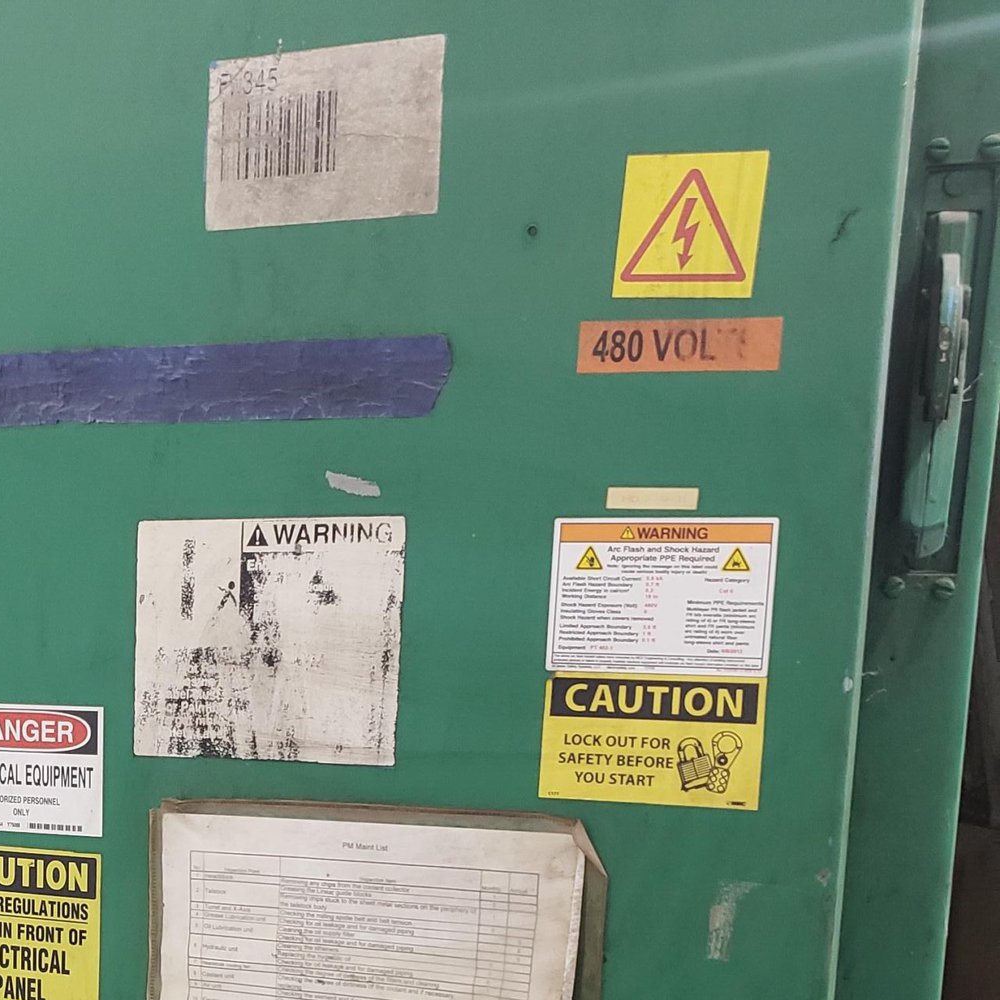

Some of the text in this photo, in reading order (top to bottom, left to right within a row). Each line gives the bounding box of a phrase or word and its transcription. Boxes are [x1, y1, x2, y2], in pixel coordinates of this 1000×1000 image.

[593, 328, 746, 362] 480 VOL
[274, 522, 392, 545] WARNING
[637, 528, 708, 539] WARNING
[565, 683, 743, 718] CAUTION
[564, 734, 670, 750] LOCK OUT FOR
[558, 752, 674, 769] SAFETY BEFORE
[26, 765, 93, 789] EQUIPMENT
[575, 771, 655, 787] YOU START
[23, 796, 60, 806] PERSONNEL
[13, 808, 29, 816] ONLY
[376, 844, 388, 852] List
[0, 921, 11, 937] IN
[18, 923, 64, 944] FRONT
[69, 928, 87, 946] OF
